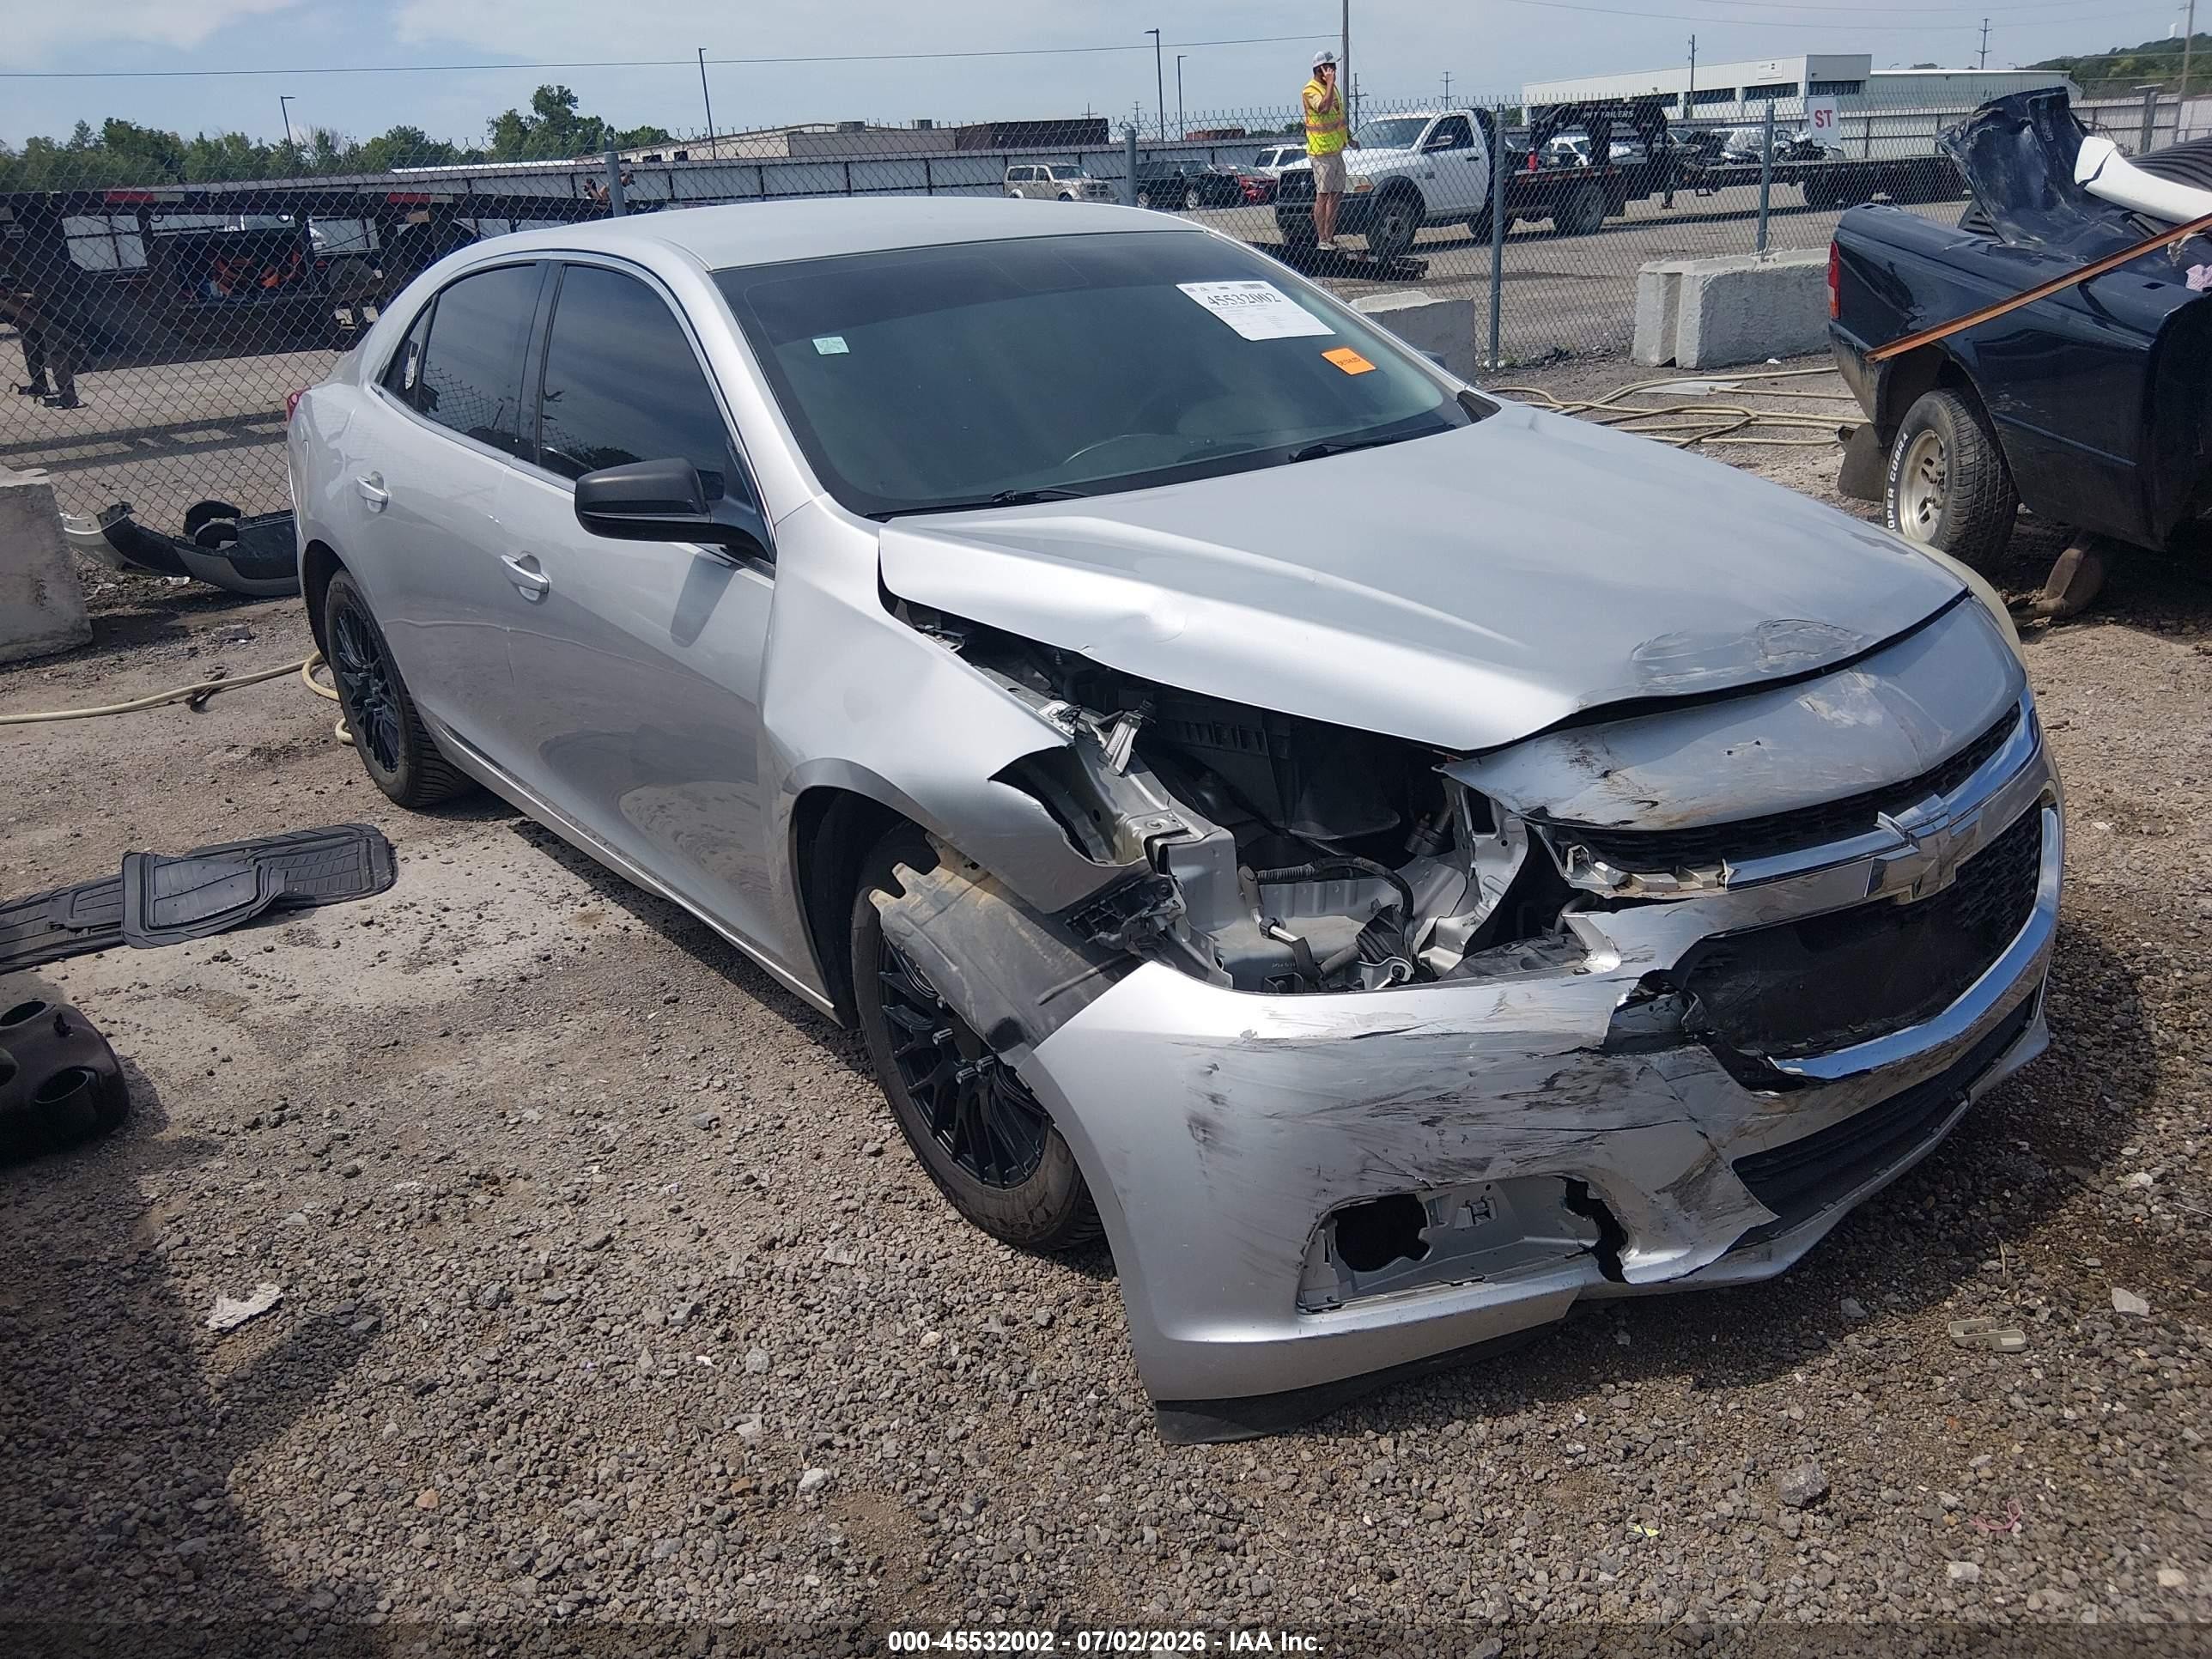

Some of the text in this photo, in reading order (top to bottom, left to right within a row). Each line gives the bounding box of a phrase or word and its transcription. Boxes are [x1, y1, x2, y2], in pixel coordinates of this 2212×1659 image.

[1814, 109, 1832, 128] ST
[1207, 292, 1281, 306] 45532002
[1887, 432, 1909, 532] OPER COBRA
